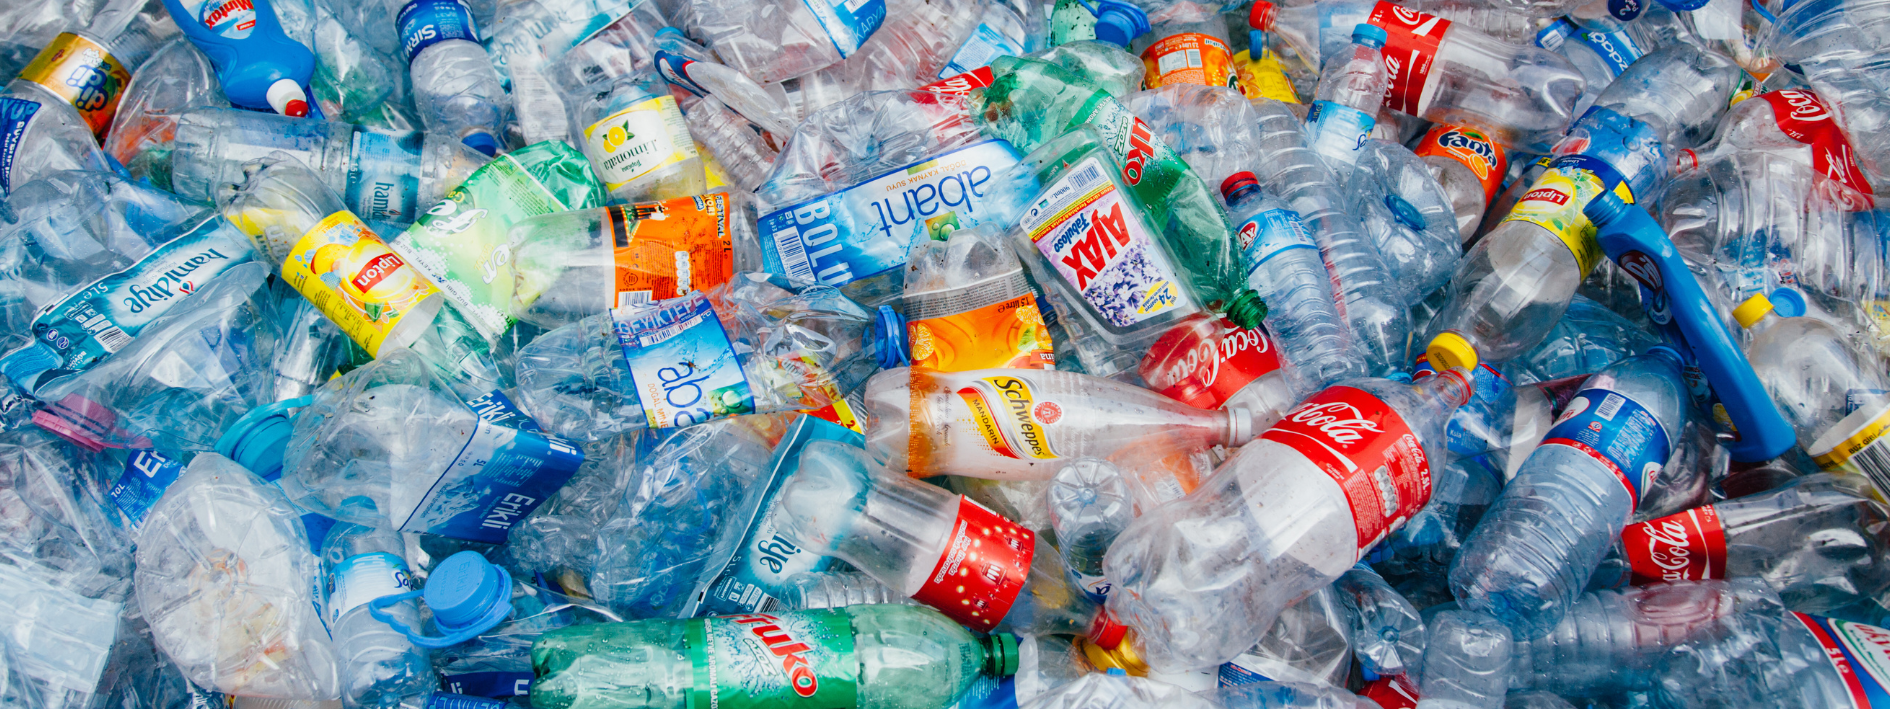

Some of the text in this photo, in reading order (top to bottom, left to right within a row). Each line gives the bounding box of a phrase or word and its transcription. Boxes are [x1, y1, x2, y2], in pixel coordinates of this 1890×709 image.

[204, 0, 254, 29] Mintax
[1438, 129, 1498, 170] Fanta
[870, 164, 992, 238] abant
[1522, 186, 1567, 206] Lipton
[793, 200, 853, 288] BOLU
[1053, 212, 1089, 253] Fabuloso
[1062, 200, 1136, 292] AJAX
[123, 248, 229, 313] hamidiye
[356, 254, 402, 289] Lipton
[1156, 288, 1174, 305] 24
[972, 398, 1000, 446] MANDARIN
[994, 379, 1046, 457] Schweppes
[110, 484, 127, 500] 10L
[482, 492, 536, 531] Erikli
[961, 536, 970, 550] Her
